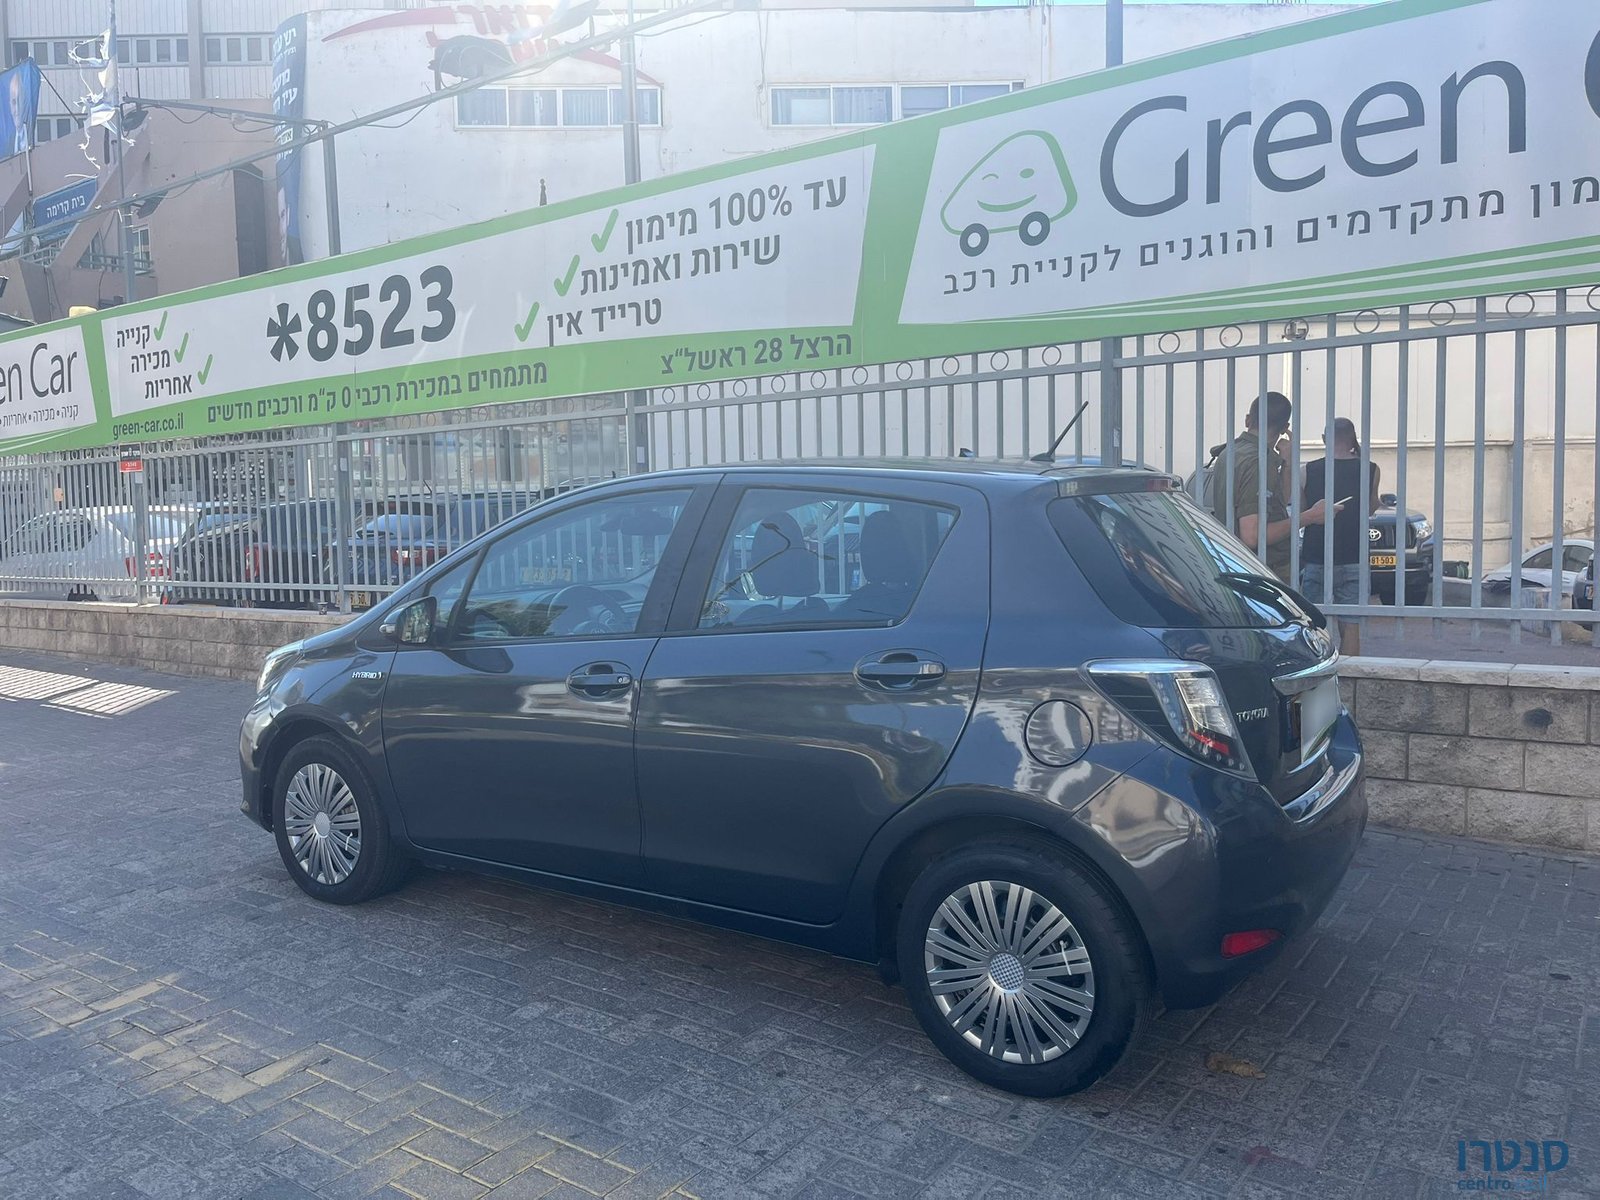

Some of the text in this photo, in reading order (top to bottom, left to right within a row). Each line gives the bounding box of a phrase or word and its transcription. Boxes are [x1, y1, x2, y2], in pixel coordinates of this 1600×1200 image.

[1099, 60, 1527, 218] Green
[71, 195, 86, 210] בית
[624, 176, 848, 256] עד 100% מימון
[1296, 189, 1505, 246] מתקדמים
[1139, 224, 1273, 270] והוגנים
[579, 234, 782, 296] שירות ואמינות
[1010, 245, 1122, 288] לקניית
[943, 268, 995, 296] רכב
[116, 325, 151, 349] קנייה
[546, 298, 663, 347] טרייד אין
[753, 337, 783, 366] 28
[790, 328, 853, 358] הרצל
[30, 342, 78, 398] Car
[130, 349, 171, 374] מכירה
[144, 374, 193, 400] אחריות
[395, 371, 463, 402] במכירת
[468, 360, 548, 393] מתמחים
[257, 393, 303, 419] ורכבים
[341, 386, 352, 409] 0
[355, 384, 391, 407] רכבי
[2, 404, 79, 428] קניה מכירה אחריות
[112, 412, 184, 441] green-car.co.il
[207, 401, 253, 424] חדשים
[351, 671, 377, 679] HYBRID
[1236, 706, 1268, 724] TOYOTA
